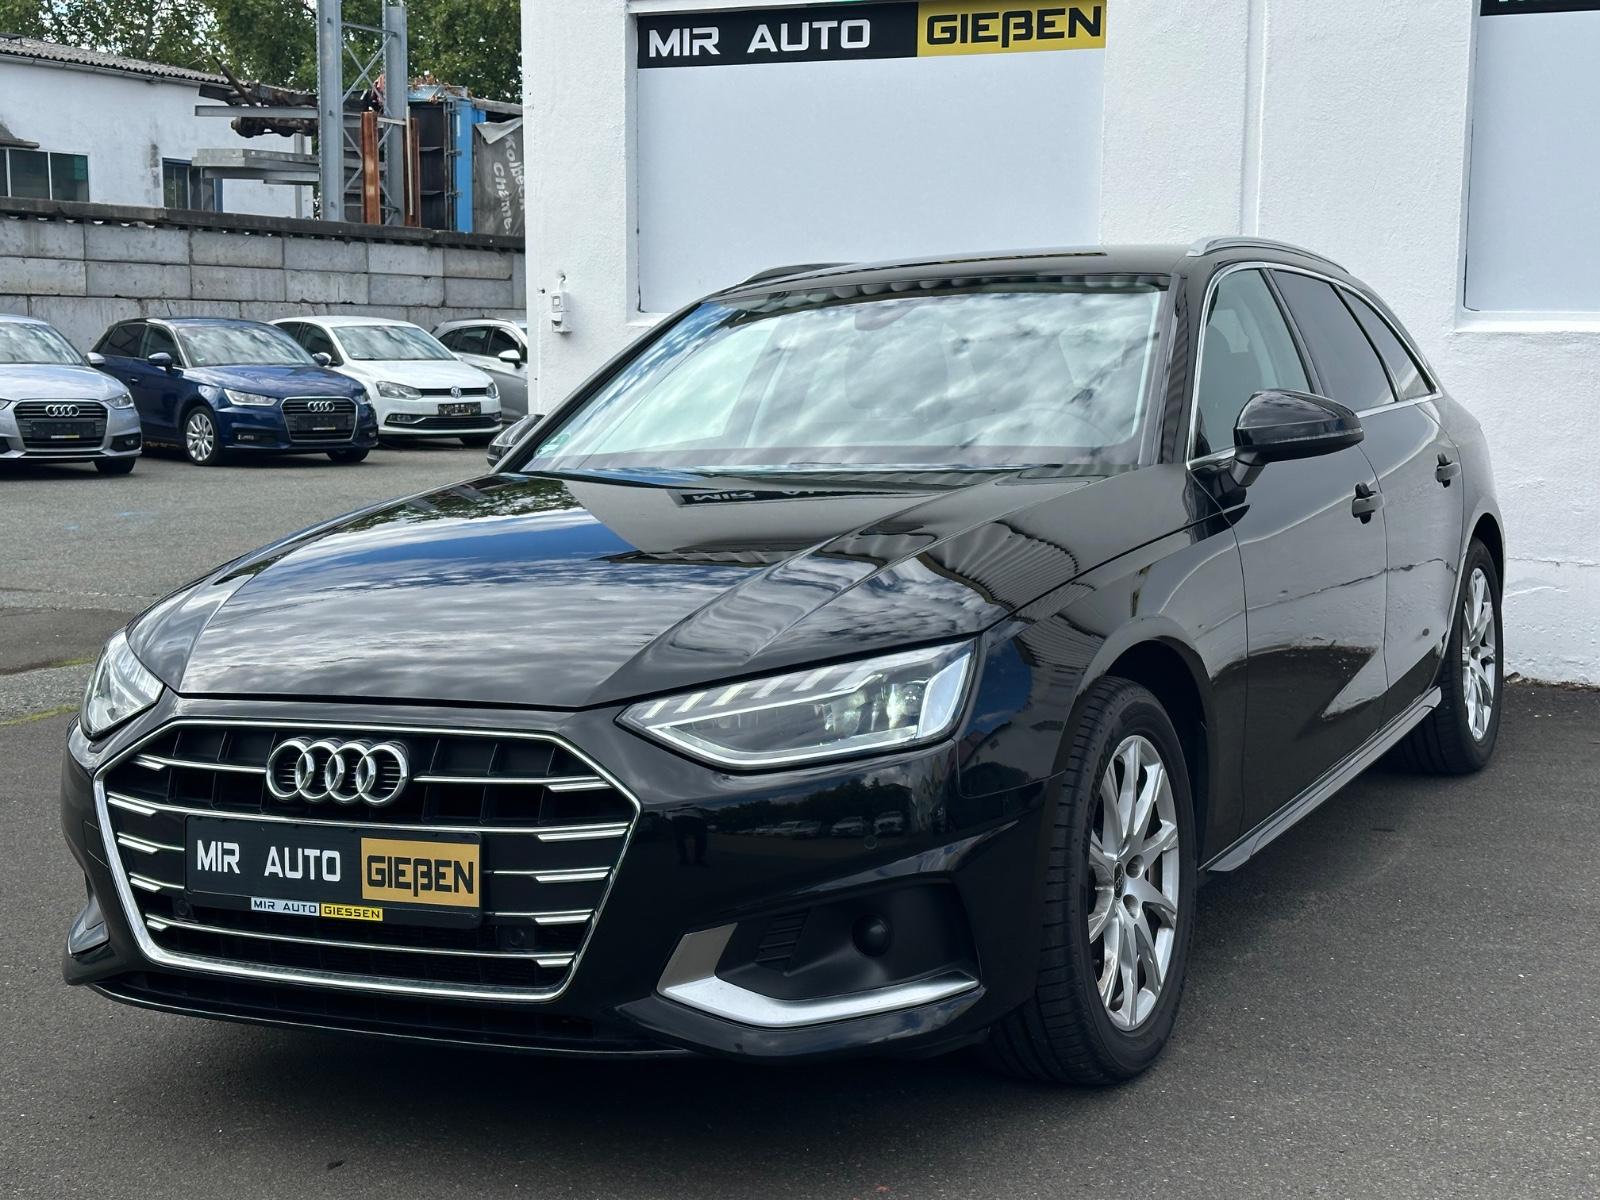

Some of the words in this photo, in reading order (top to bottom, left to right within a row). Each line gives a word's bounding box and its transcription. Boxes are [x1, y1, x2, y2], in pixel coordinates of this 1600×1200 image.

[648, 26, 721, 58] MIR
[747, 18, 871, 54] AUTO
[926, 6, 1102, 49] GIEßEN
[196, 839, 241, 875] MIR
[263, 846, 342, 883] AUTO
[366, 854, 475, 898] GIEßEN
[253, 900, 276, 911] MIR
[282, 902, 318, 915] AUTO
[323, 905, 382, 920] GIESSEN
